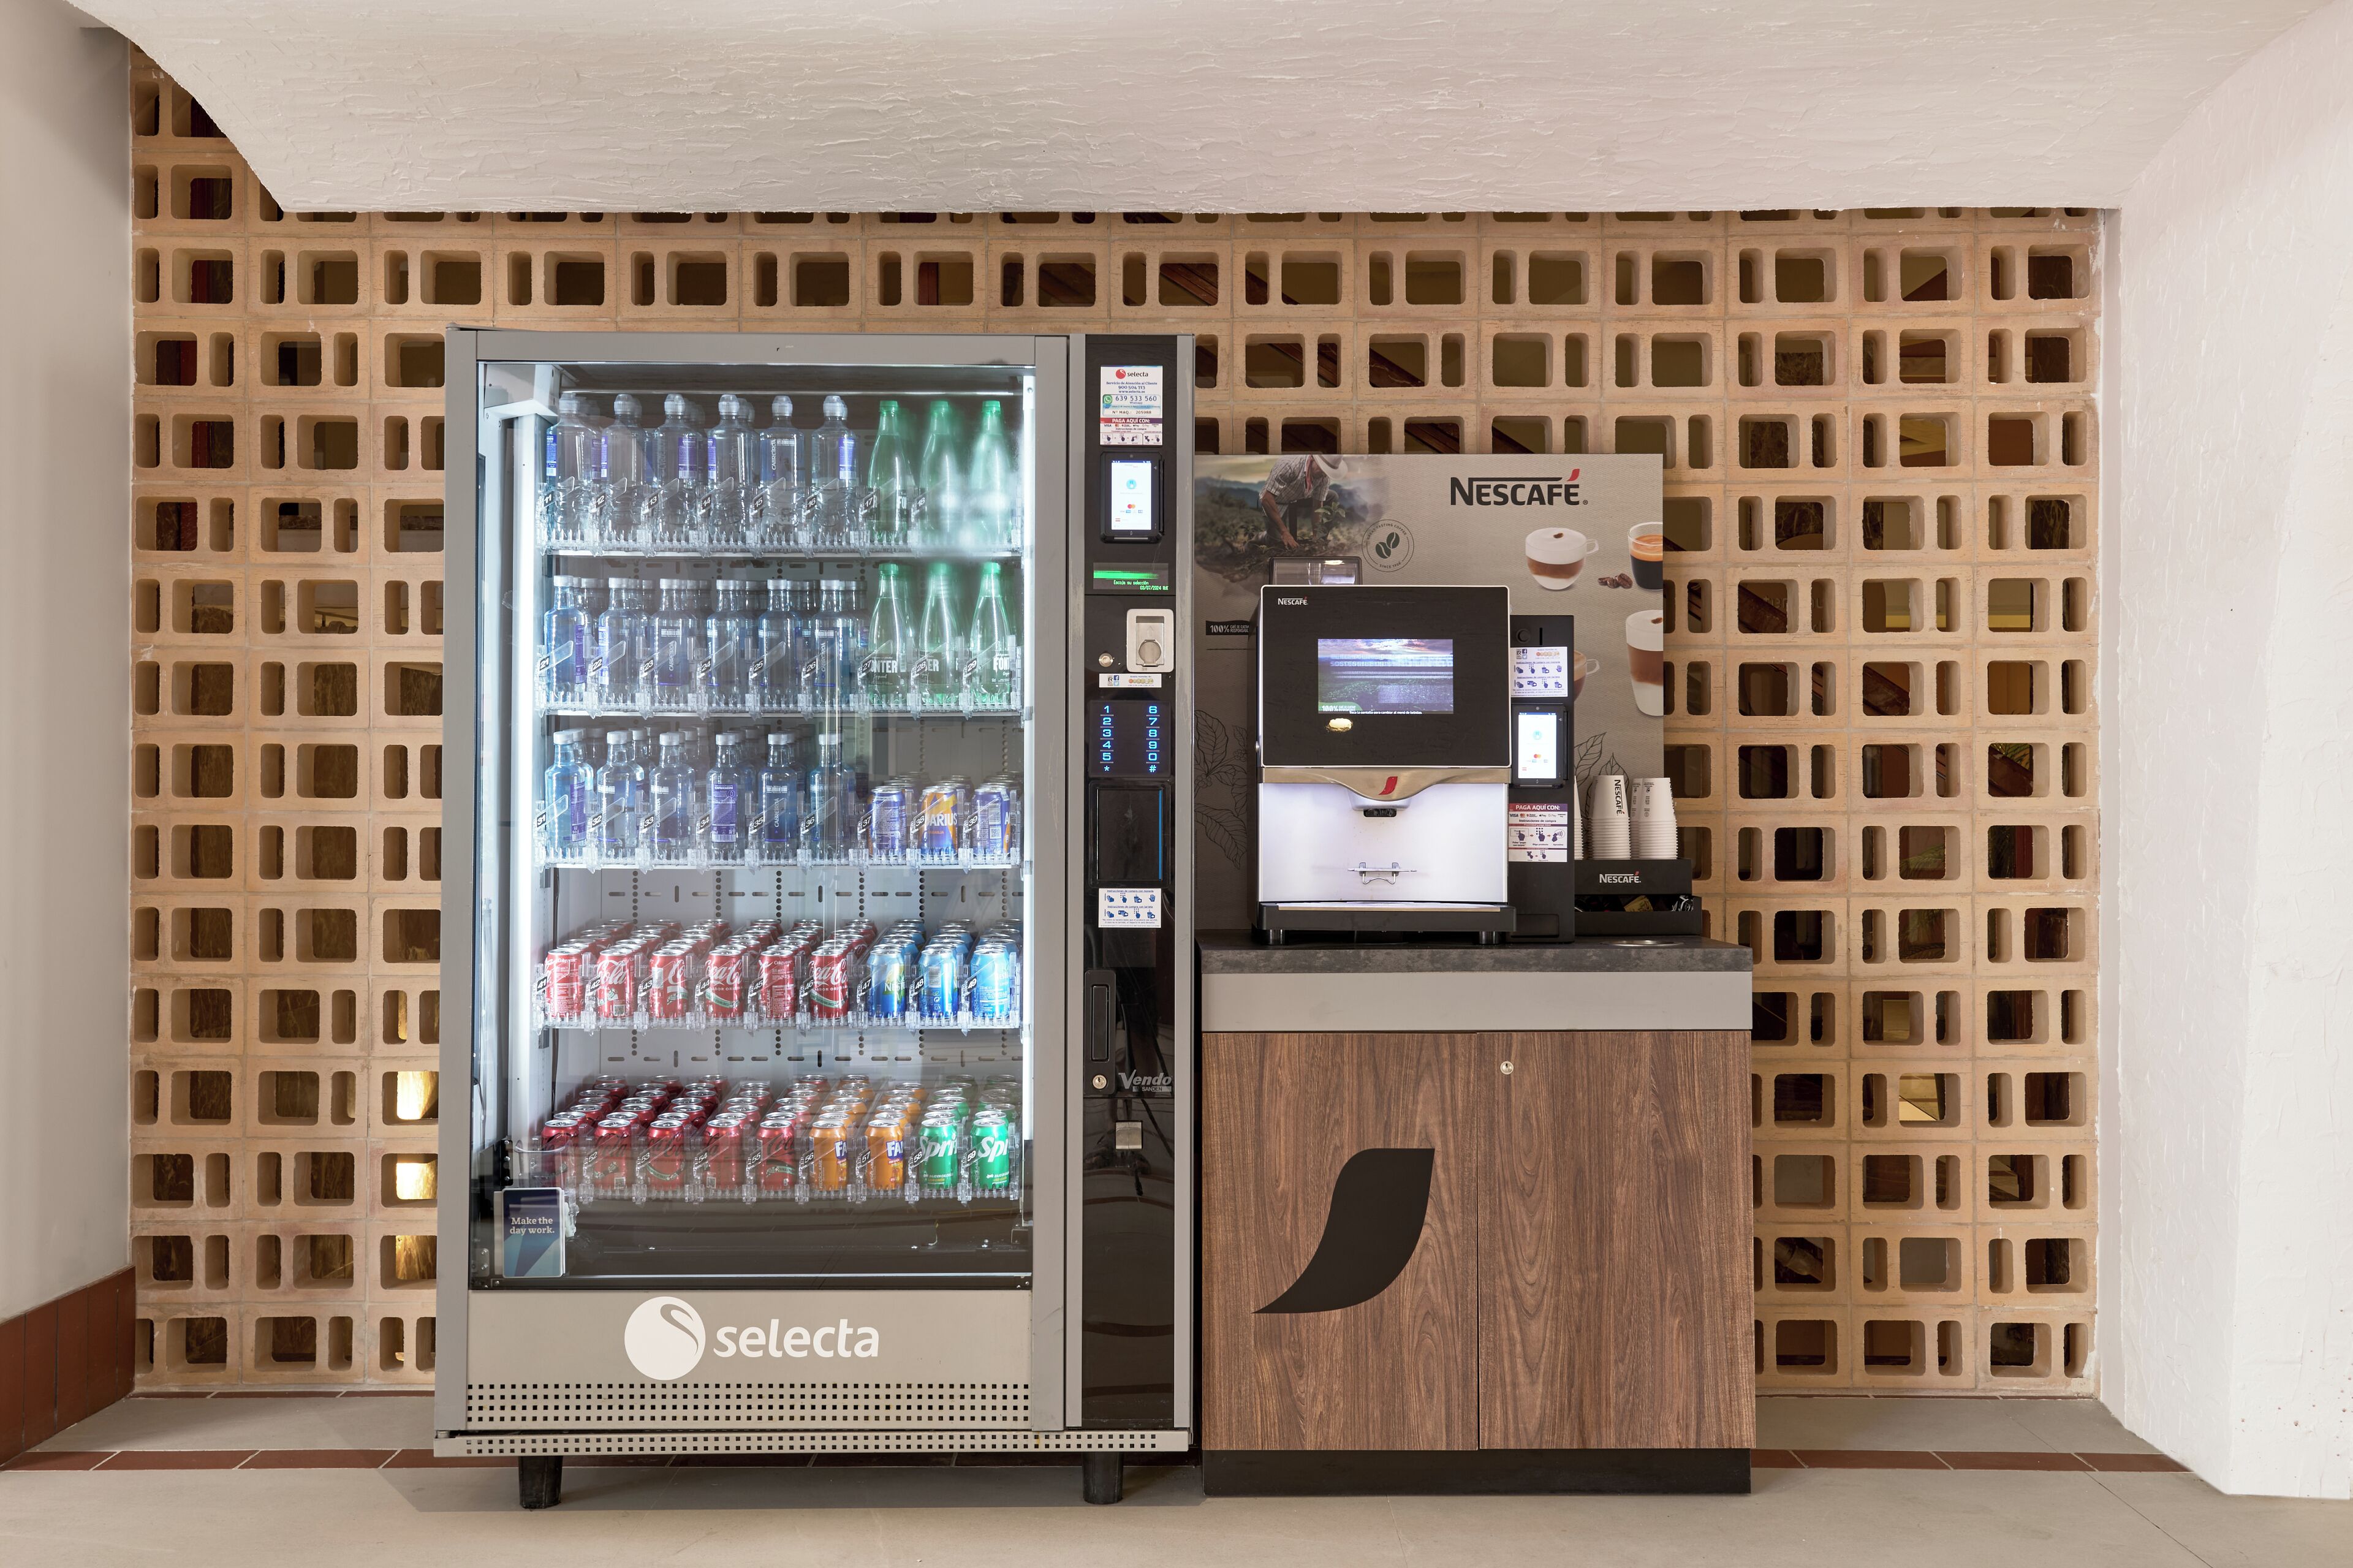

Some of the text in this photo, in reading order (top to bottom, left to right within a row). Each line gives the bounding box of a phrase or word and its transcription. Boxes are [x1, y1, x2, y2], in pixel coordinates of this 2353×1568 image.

[1450, 468, 1580, 506] NESCAFÉ
[544, 494, 552, 503] 11
[596, 495, 605, 505] 12
[649, 496, 657, 505] 13
[702, 497, 711, 507] 14
[754, 498, 763, 507] 15
[807, 498, 816, 506] 16
[865, 498, 874, 507] 17
[917, 498, 925, 507] 18
[1278, 595, 1308, 605] NESCAFÉ
[1210, 624, 1230, 633] 100%
[540, 658, 549, 669] 21
[593, 659, 602, 670] 22
[644, 659, 653, 670] 23
[702, 661, 711, 672] 24
[754, 662, 763, 672] 25
[806, 662, 816, 672] 26
[863, 659, 872, 671] 27
[917, 661, 926, 671] 28
[968, 660, 976, 671] 29
[1148, 705, 1158, 714] 6
[1102, 717, 1112, 725] 2
[1148, 717, 1158, 725] 7
[1102, 729, 1112, 737] 3
[1102, 740, 1112, 749] 4
[1148, 741, 1158, 749] 9
[1102, 752, 1112, 760] 5
[1148, 752, 1158, 761] 0
[1614, 779, 1625, 815] NESCAFÉ
[592, 815, 602, 825] 32
[644, 816, 654, 825] 33
[700, 817, 710, 827] 34
[754, 817, 763, 827] 35
[805, 816, 814, 826] 36
[862, 816, 871, 826] 37
[915, 816, 925, 826] 38
[968, 816, 978, 826] 39
[1599, 871, 1640, 884] NESCAFÉ
[537, 979, 547, 989] 41
[590, 980, 600, 990] 42
[643, 980, 653, 990] 43
[753, 981, 763, 990] 45
[805, 981, 814, 990] 46
[862, 979, 871, 989] 47
[915, 978, 924, 989] 48
[968, 978, 977, 989] 49
[1118, 1069, 1172, 1089] Vendo
[588, 1152, 597, 1162] 52
[641, 1152, 650, 1163] 53
[699, 1153, 707, 1163] 54
[752, 1152, 761, 1163] 55
[805, 1153, 814, 1162] 56
[862, 1151, 870, 1162] 57
[914, 1151, 923, 1162] 58
[967, 1151, 976, 1162] 59
[509, 1226, 526, 1236] day
[713, 1318, 879, 1358] selecta
